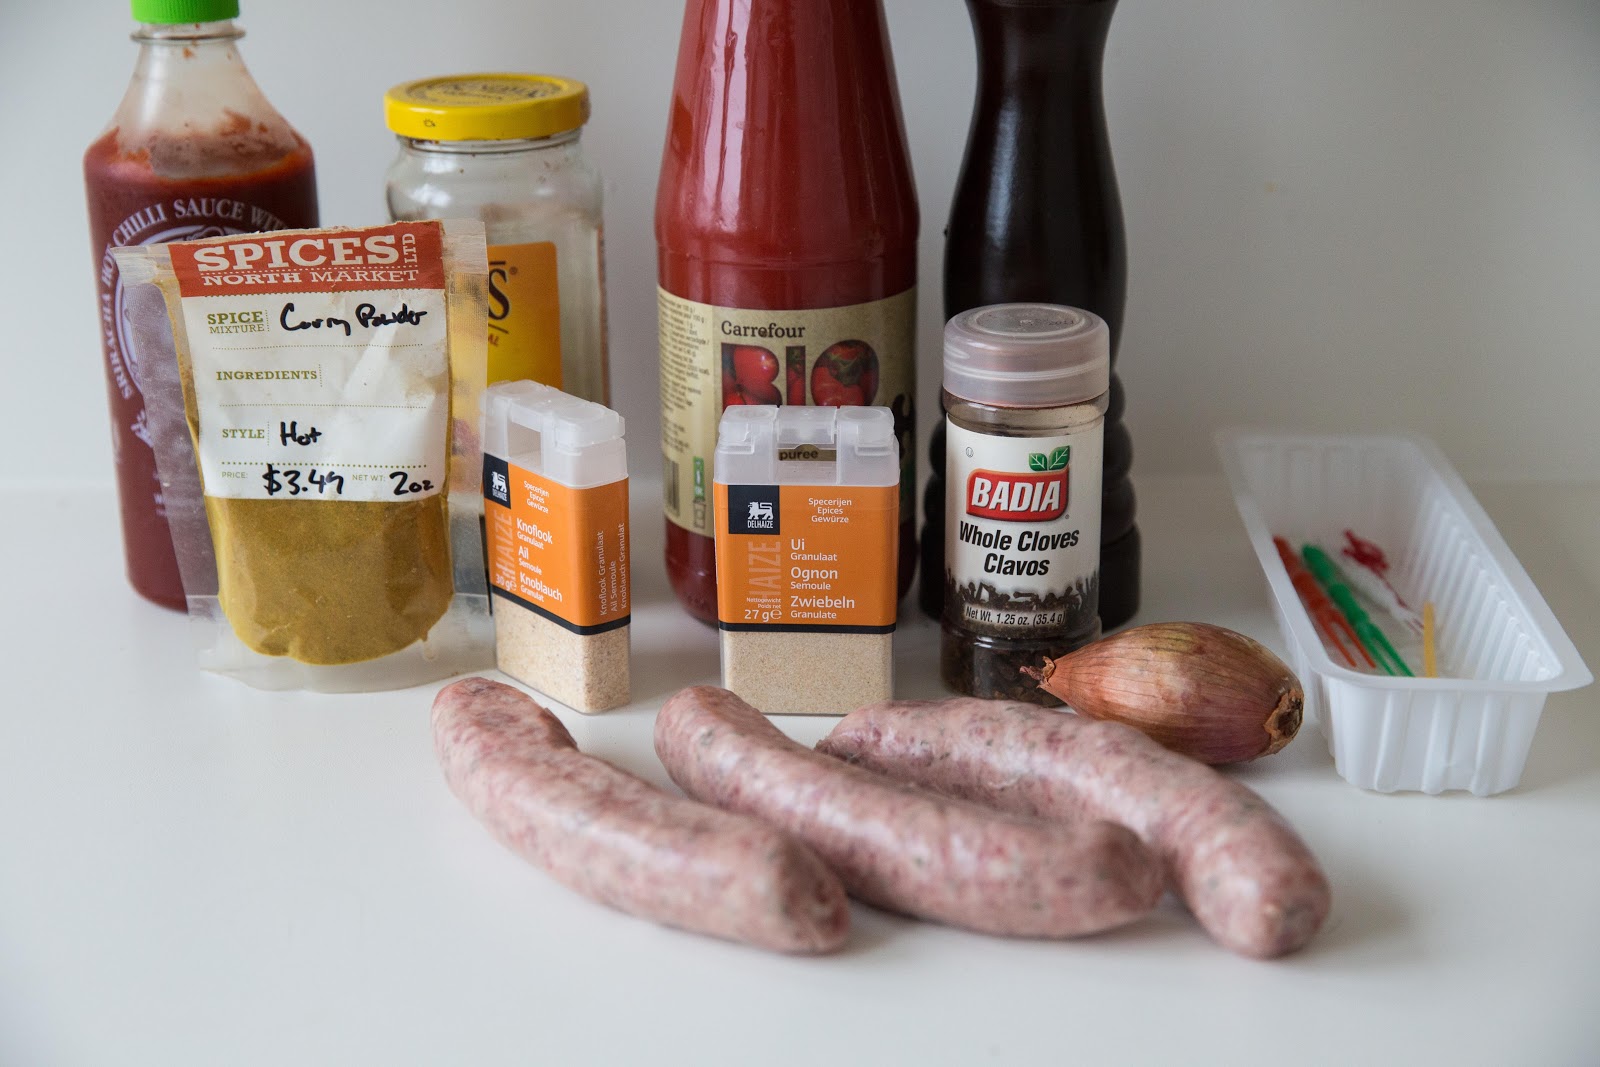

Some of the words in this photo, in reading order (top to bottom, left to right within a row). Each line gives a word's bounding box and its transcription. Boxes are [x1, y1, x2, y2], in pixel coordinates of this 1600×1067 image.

[173, 198, 244, 219] SAUCE
[112, 203, 167, 247] CHILLI
[193, 235, 399, 272] SPICES
[402, 233, 418, 263] LTD
[202, 272, 303, 286] NORTH
[310, 269, 419, 283] MARKET
[207, 311, 263, 325] SPICE
[355, 303, 428, 328] Powder
[209, 325, 265, 335] MIXTURE
[721, 320, 806, 338] Carrefour
[102, 293, 133, 399] SRIRACHA
[216, 371, 317, 381] INGREDIENTS
[721, 339, 880, 408] BIO
[222, 428, 265, 439] STYLE
[280, 421, 322, 446] Hot
[221, 471, 248, 479] PRICE:
[262, 464, 344, 496] $3.49
[352, 474, 369, 482] NET
[370, 474, 386, 482] WT:
[529, 491, 545, 503] Epices
[808, 498, 852, 507] Specerijen
[971, 477, 1061, 513] BADIA
[811, 514, 849, 523] Gewürze
[817, 506, 844, 515] Epices
[516, 517, 553, 545] Knoflook
[747, 520, 774, 529] DELHAIZE
[517, 532, 545, 550] Granulaat
[790, 538, 805, 551] Ui
[959, 520, 1012, 551] Whole
[1017, 529, 1080, 552] Cloves
[518, 545, 529, 560] Ail
[597, 530, 606, 576] Granulaat
[790, 552, 838, 562] Granulaat
[518, 557, 543, 576] Semoule
[983, 552, 1050, 576] Clavos
[608, 560, 617, 600] Semoule
[790, 566, 838, 582] Ognon
[520, 572, 563, 602] Knoblauch
[619, 563, 627, 609] Knoblauch
[790, 582, 831, 590] Semoule
[598, 577, 607, 616] Knoflook
[790, 595, 855, 609] Zwiebeln
[610, 600, 618, 612] Ail
[790, 610, 837, 620] Granulate
[965, 606, 978, 620] Net
[980, 609, 993, 623] Wt.
[996, 612, 1016, 625] 1.25
[1017, 616, 1030, 626] oz.
[1032, 612, 1056, 628] (35.4
